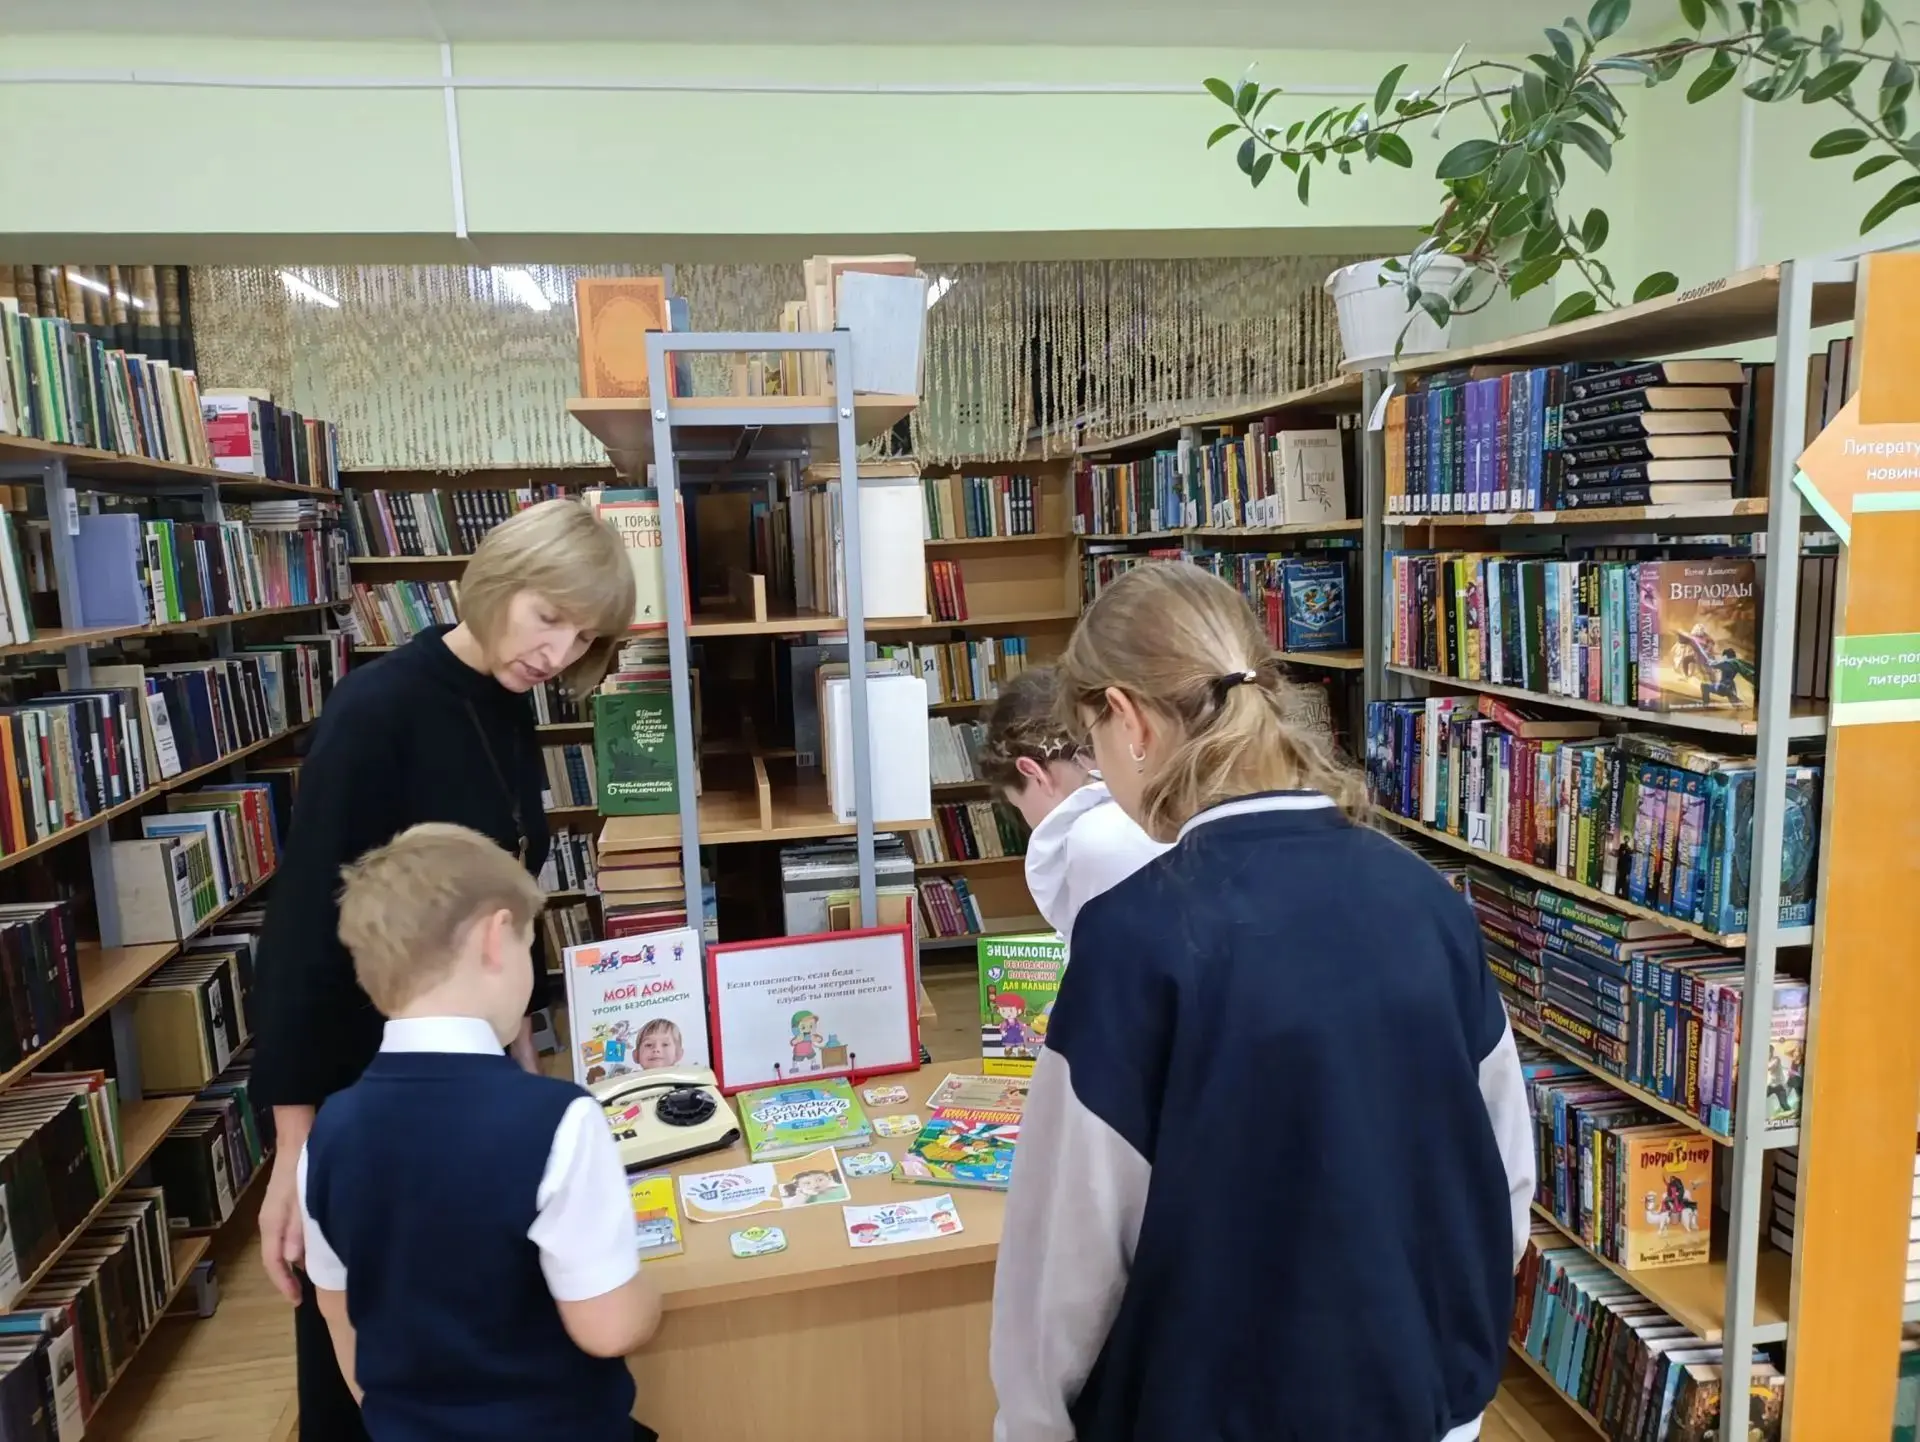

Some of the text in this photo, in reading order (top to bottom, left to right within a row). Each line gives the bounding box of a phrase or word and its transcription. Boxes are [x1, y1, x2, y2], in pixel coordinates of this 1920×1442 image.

[1866, 467, 1920, 480] новин
[621, 529, 663, 549] ЕТСТВ
[1670, 582, 1753, 600] ВЕРЛОРДЫ
[924, 659, 934, 672] Я
[1472, 818, 1487, 847] Д
[603, 984, 636, 1002] МОЙ
[641, 978, 675, 998] ДОМ
[727, 980, 751, 990] Если
[807, 971, 830, 980] если
[1003, 981, 1019, 991] ДЛЯ
[592, 993, 690, 1016] УРОКИ БЕЗОПАСНОСТИ
[809, 993, 822, 1001] ты
[824, 989, 855, 999] помни
[753, 1098, 849, 1120] БЕЗОПАСНОСТЬ
